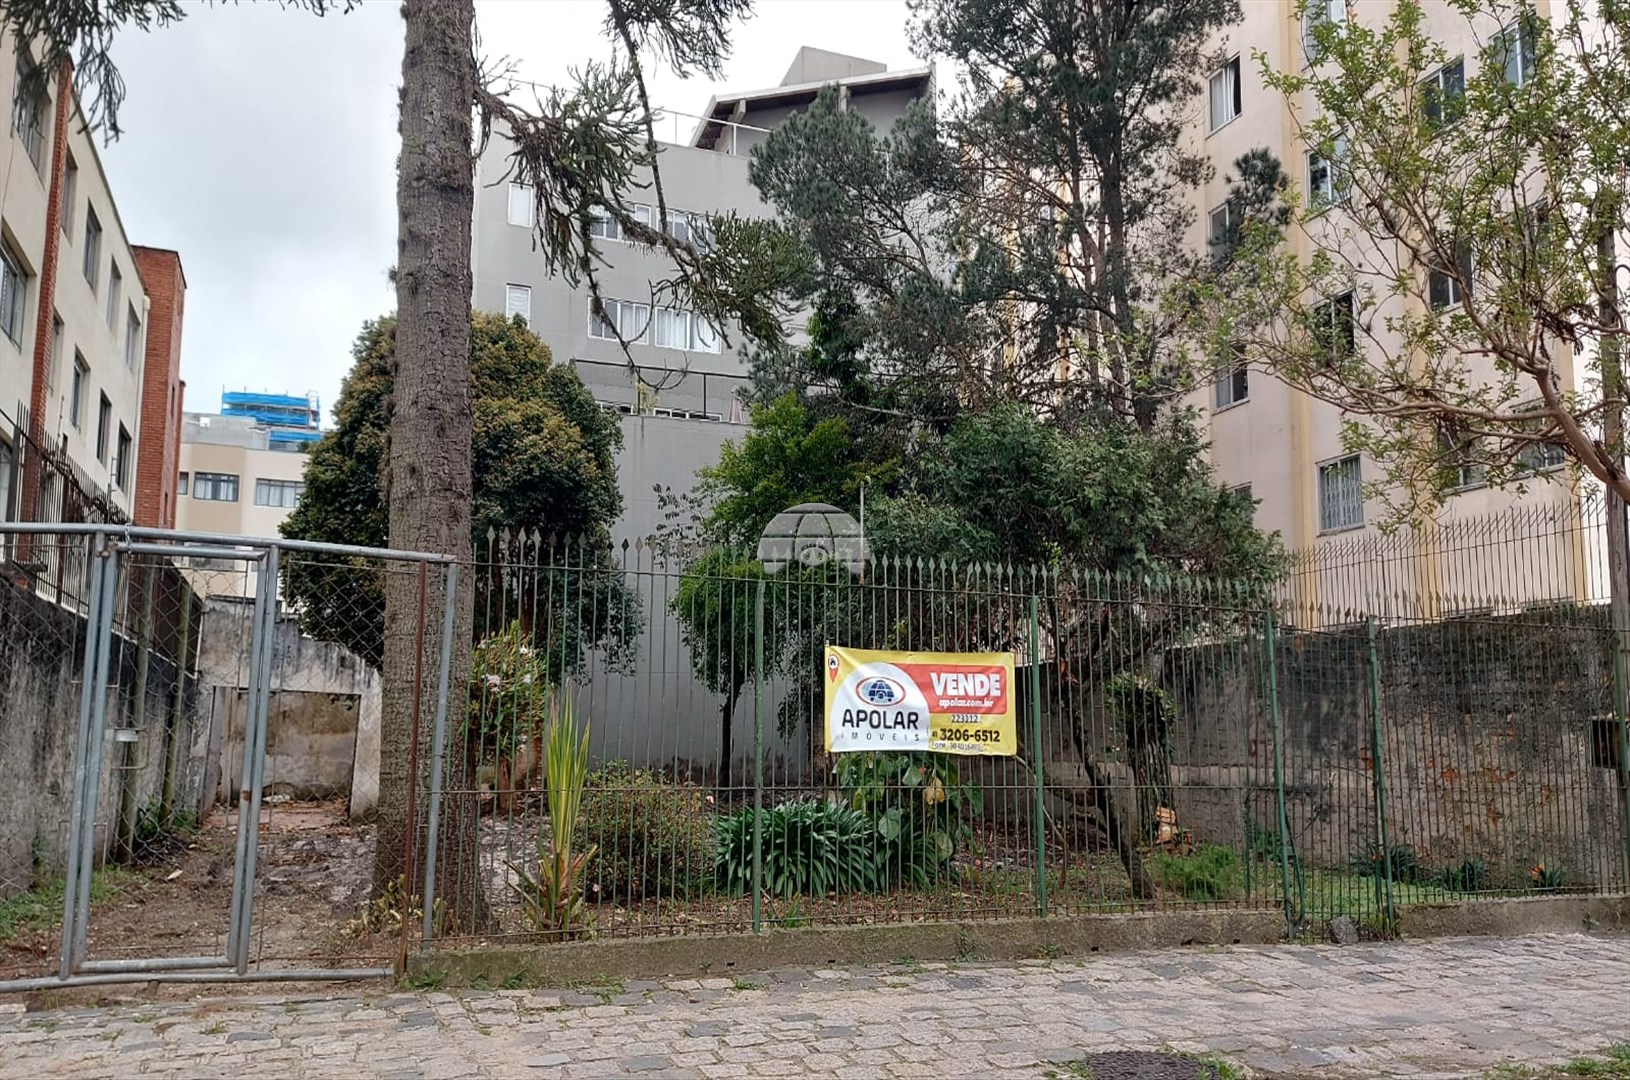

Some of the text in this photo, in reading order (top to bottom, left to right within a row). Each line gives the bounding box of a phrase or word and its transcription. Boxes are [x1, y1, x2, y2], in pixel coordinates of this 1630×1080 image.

[930, 672, 1001, 696] VENDE
[939, 697, 994, 709] apolar.com.br
[842, 708, 919, 730] APOLAR
[841, 731, 920, 742] IMÓVEIS
[940, 728, 1001, 743] 3206-6512
